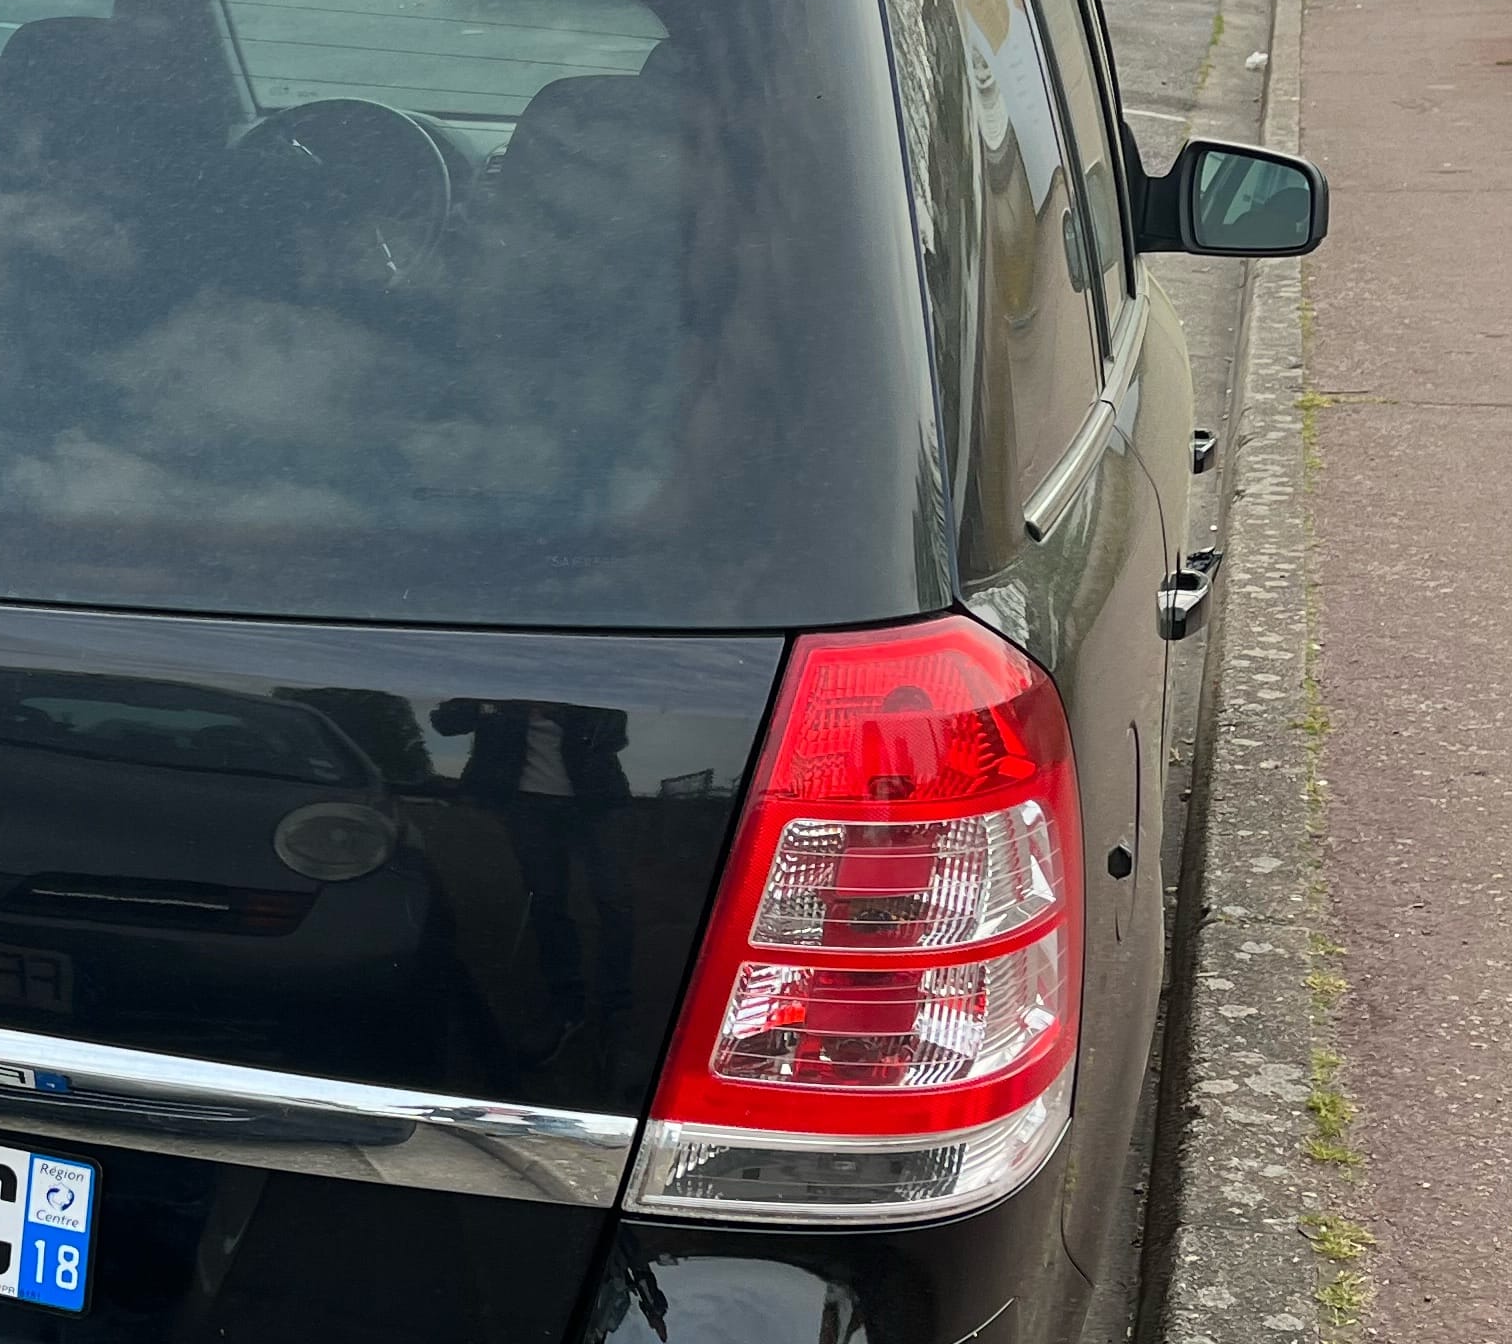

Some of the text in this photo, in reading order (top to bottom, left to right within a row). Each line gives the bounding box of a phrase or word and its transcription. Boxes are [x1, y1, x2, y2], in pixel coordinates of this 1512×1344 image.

[39, 1163, 85, 1183] Région
[36, 1209, 80, 1228] Centre
[34, 1240, 80, 1291] 18
